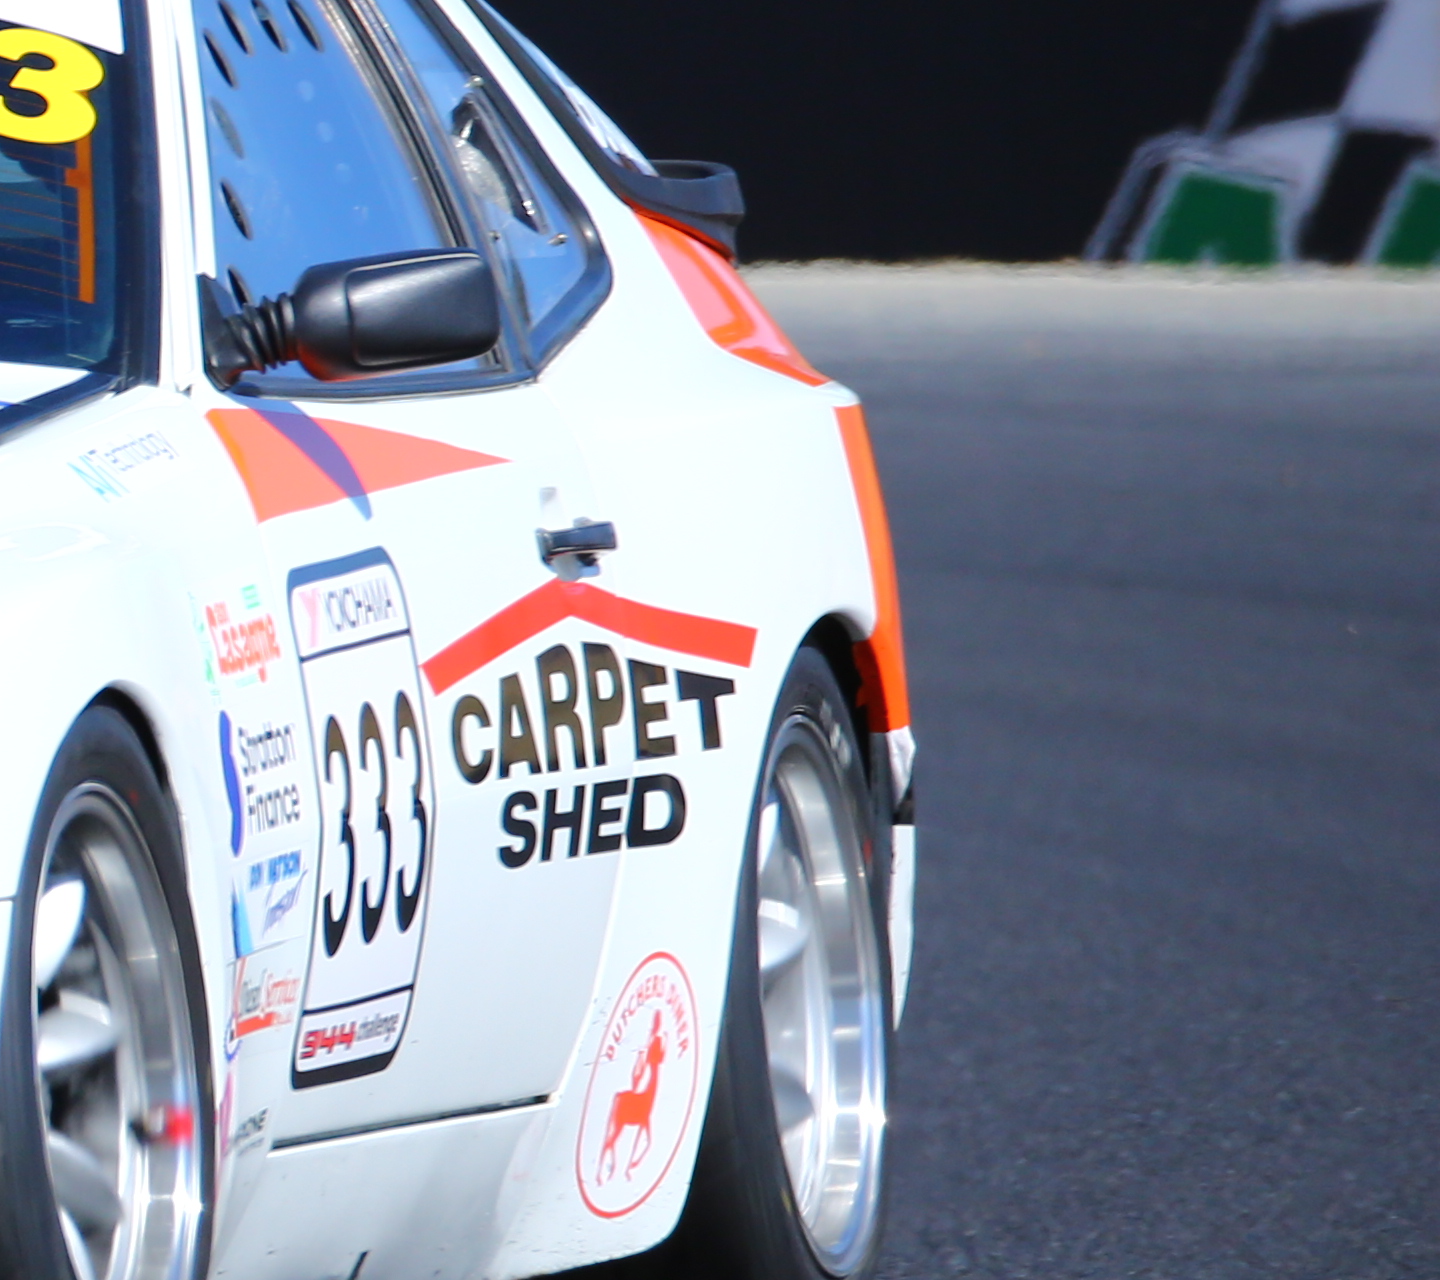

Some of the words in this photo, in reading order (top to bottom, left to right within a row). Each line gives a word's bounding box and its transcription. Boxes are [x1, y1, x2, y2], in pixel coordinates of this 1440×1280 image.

[450, 641, 738, 786] CARPET
[245, 783, 302, 840] Finance
[322, 689, 431, 959] 333
[498, 773, 687, 870] SHED
[299, 1019, 358, 1061] 944
